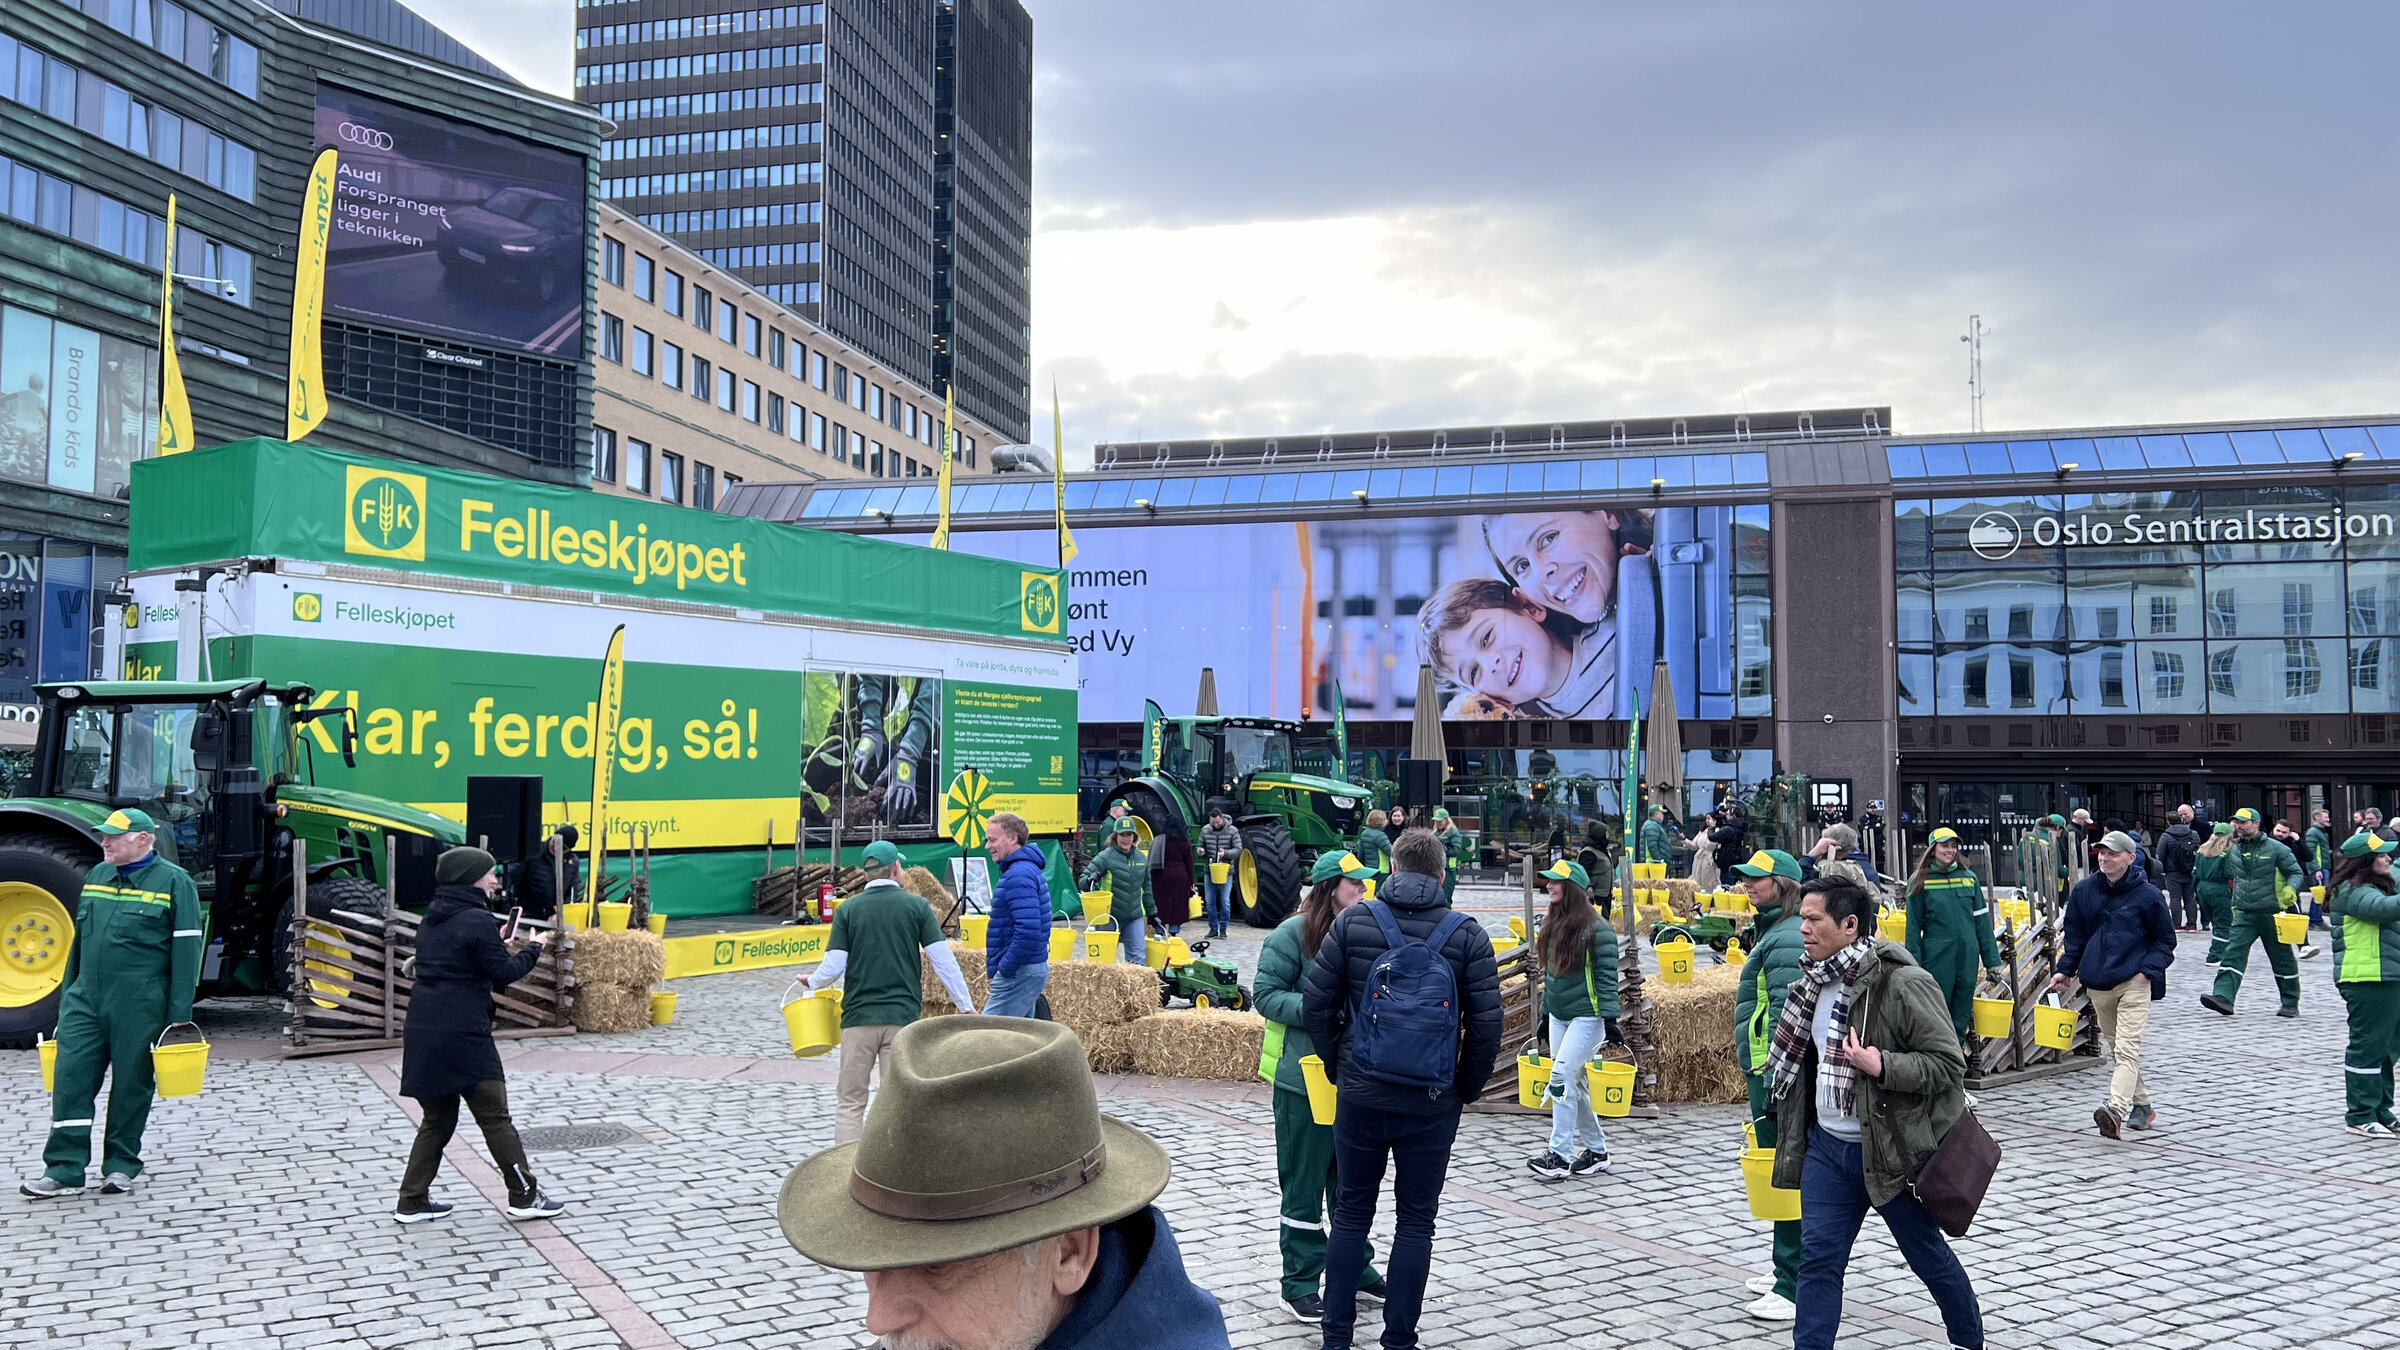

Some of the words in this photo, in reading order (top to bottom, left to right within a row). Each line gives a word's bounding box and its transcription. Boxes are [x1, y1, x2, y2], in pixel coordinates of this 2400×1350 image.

[338, 163, 381, 184] Audi
[338, 180, 446, 217] Forspranget
[338, 198, 390, 220] ligger
[395, 212, 399, 224] i
[336, 217, 423, 247] teknikken
[437, 351, 455, 362] Clear
[455, 355, 483, 366] Channel
[66, 347, 84, 424] Brando
[65, 429, 81, 469] kids
[2033, 514, 2113, 547] Oslo
[2123, 507, 2394, 546] Sentralstasjon
[461, 498, 746, 590] Felleskjøpet
[1071, 569, 1147, 587] mmen
[336, 601, 455, 631] Felleskjøpet
[1101, 629, 1135, 656] Vy
[0, 704, 40, 724] DO
[291, 690, 450, 768] Klar,
[468, 697, 668, 773] ferdg,
[683, 698, 758, 760] så!
[741, 937, 821, 959] Felleskjøpet
